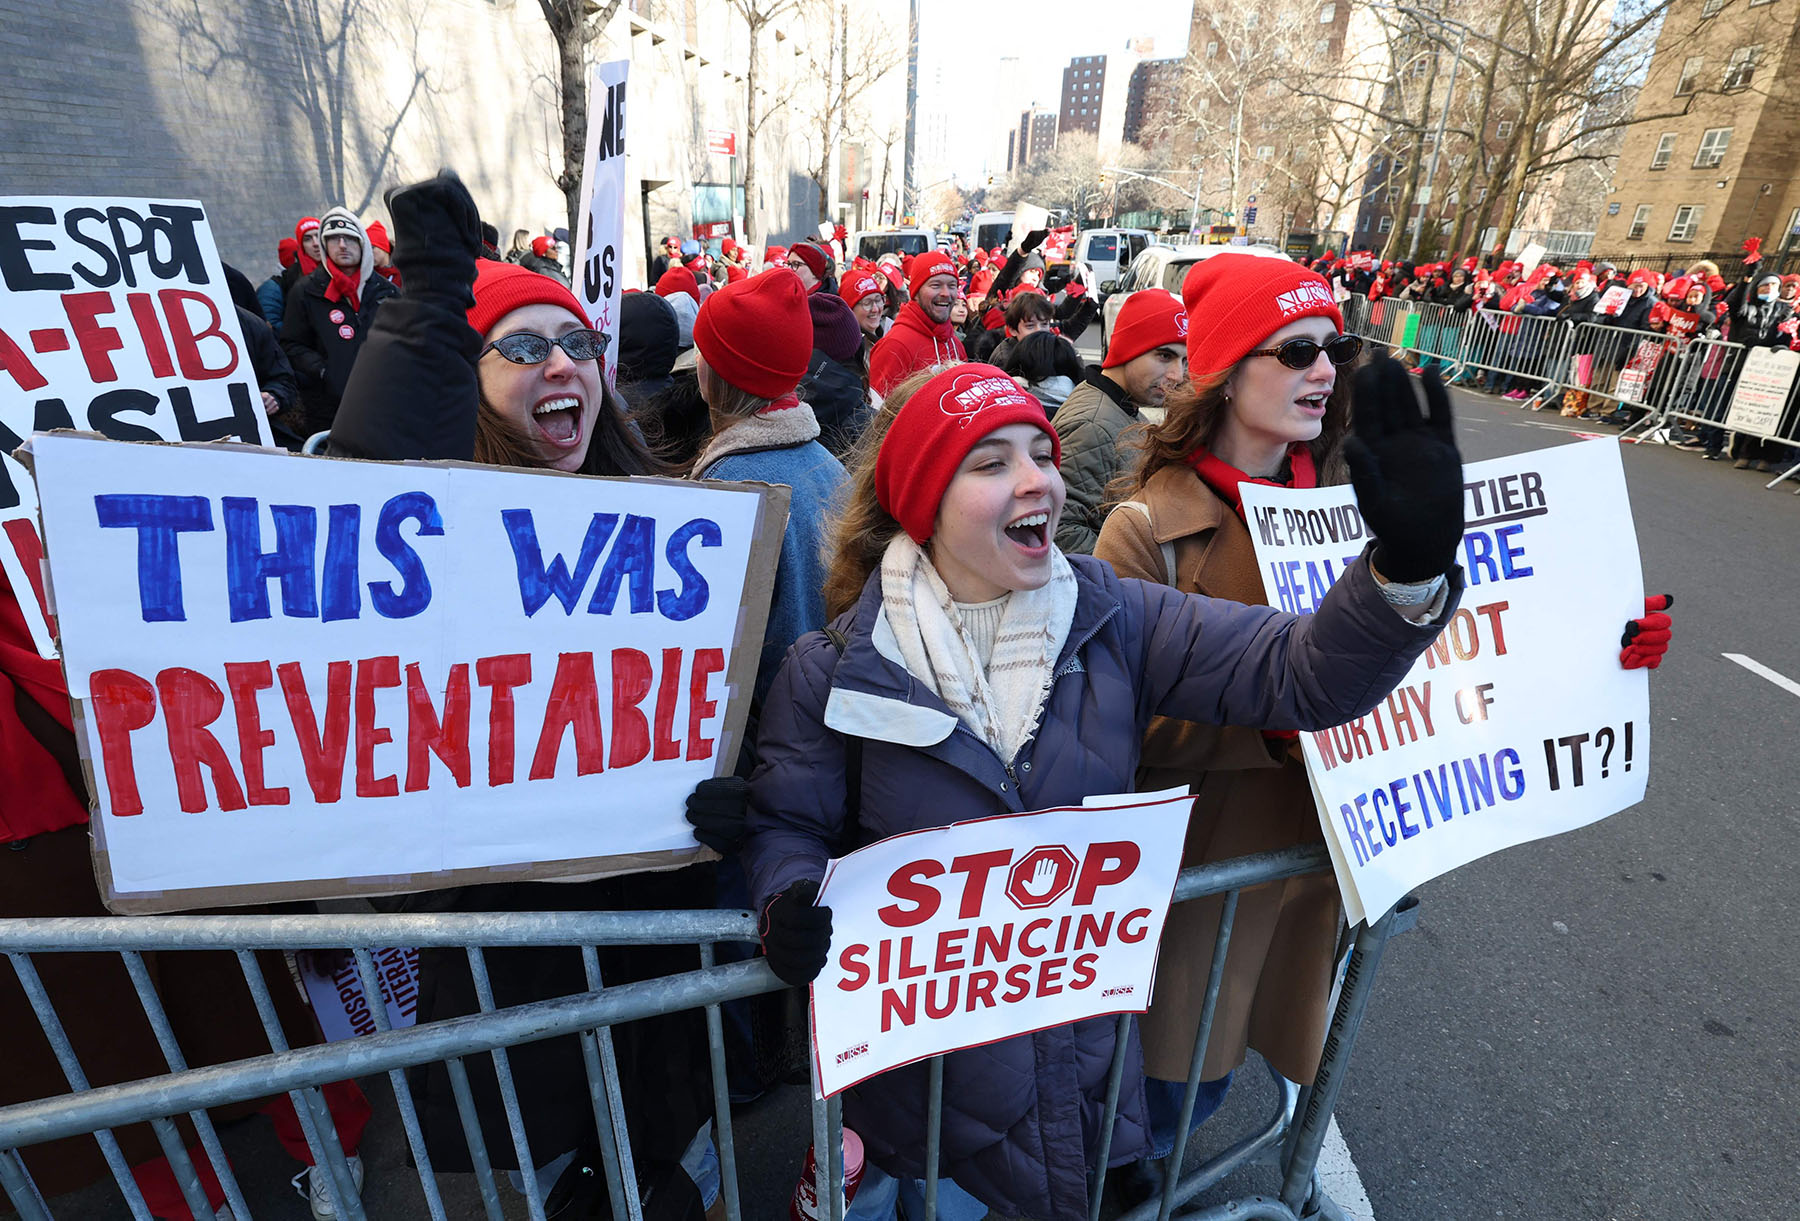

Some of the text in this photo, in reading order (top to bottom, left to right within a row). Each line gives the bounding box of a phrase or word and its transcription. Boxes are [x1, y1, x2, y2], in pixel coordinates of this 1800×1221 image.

[94, 491, 445, 623] THIS
[502, 508, 723, 622] WAS
[1254, 505, 1285, 547] WE
[90, 646, 726, 817] PREVENTABLE
[1340, 721, 1634, 868] RECEIVING IT?!
[837, 907, 1153, 993] SILENCING
[881, 953, 1100, 1033] NURSES
